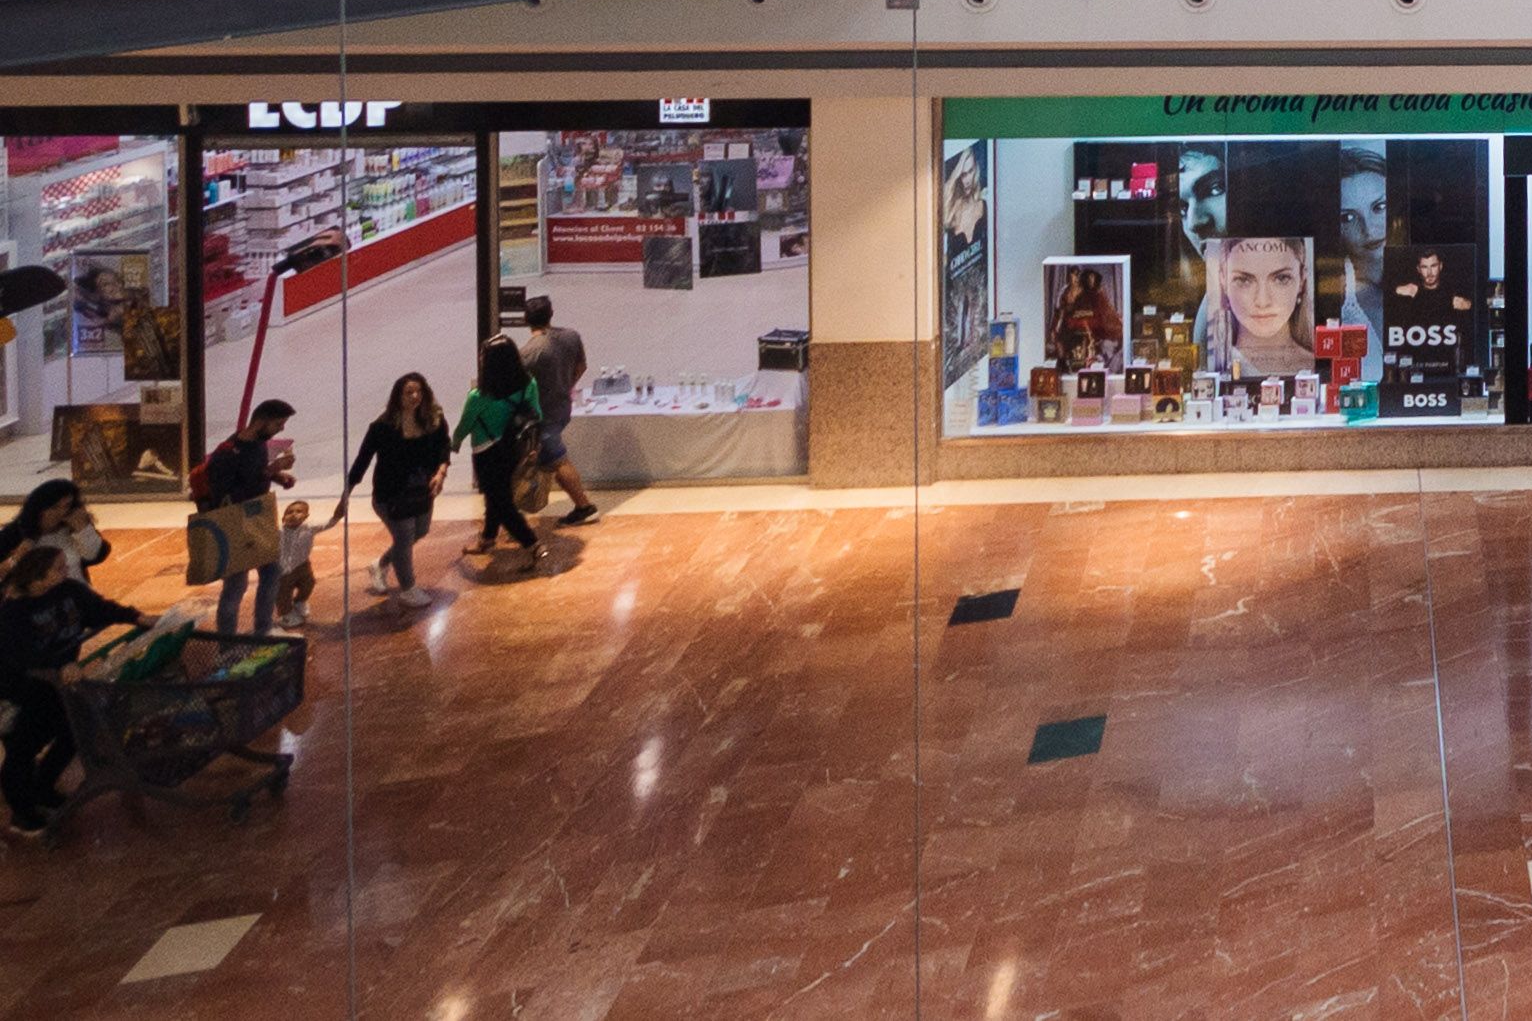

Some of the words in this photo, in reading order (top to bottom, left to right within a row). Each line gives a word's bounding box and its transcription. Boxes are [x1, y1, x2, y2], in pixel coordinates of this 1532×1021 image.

[1213, 95, 1304, 114] aroma
[1311, 94, 1378, 124] para
[1230, 240, 1297, 253] ANCÔM
[1388, 324, 1457, 347] BOSS
[1403, 393, 1447, 408] BOSS
